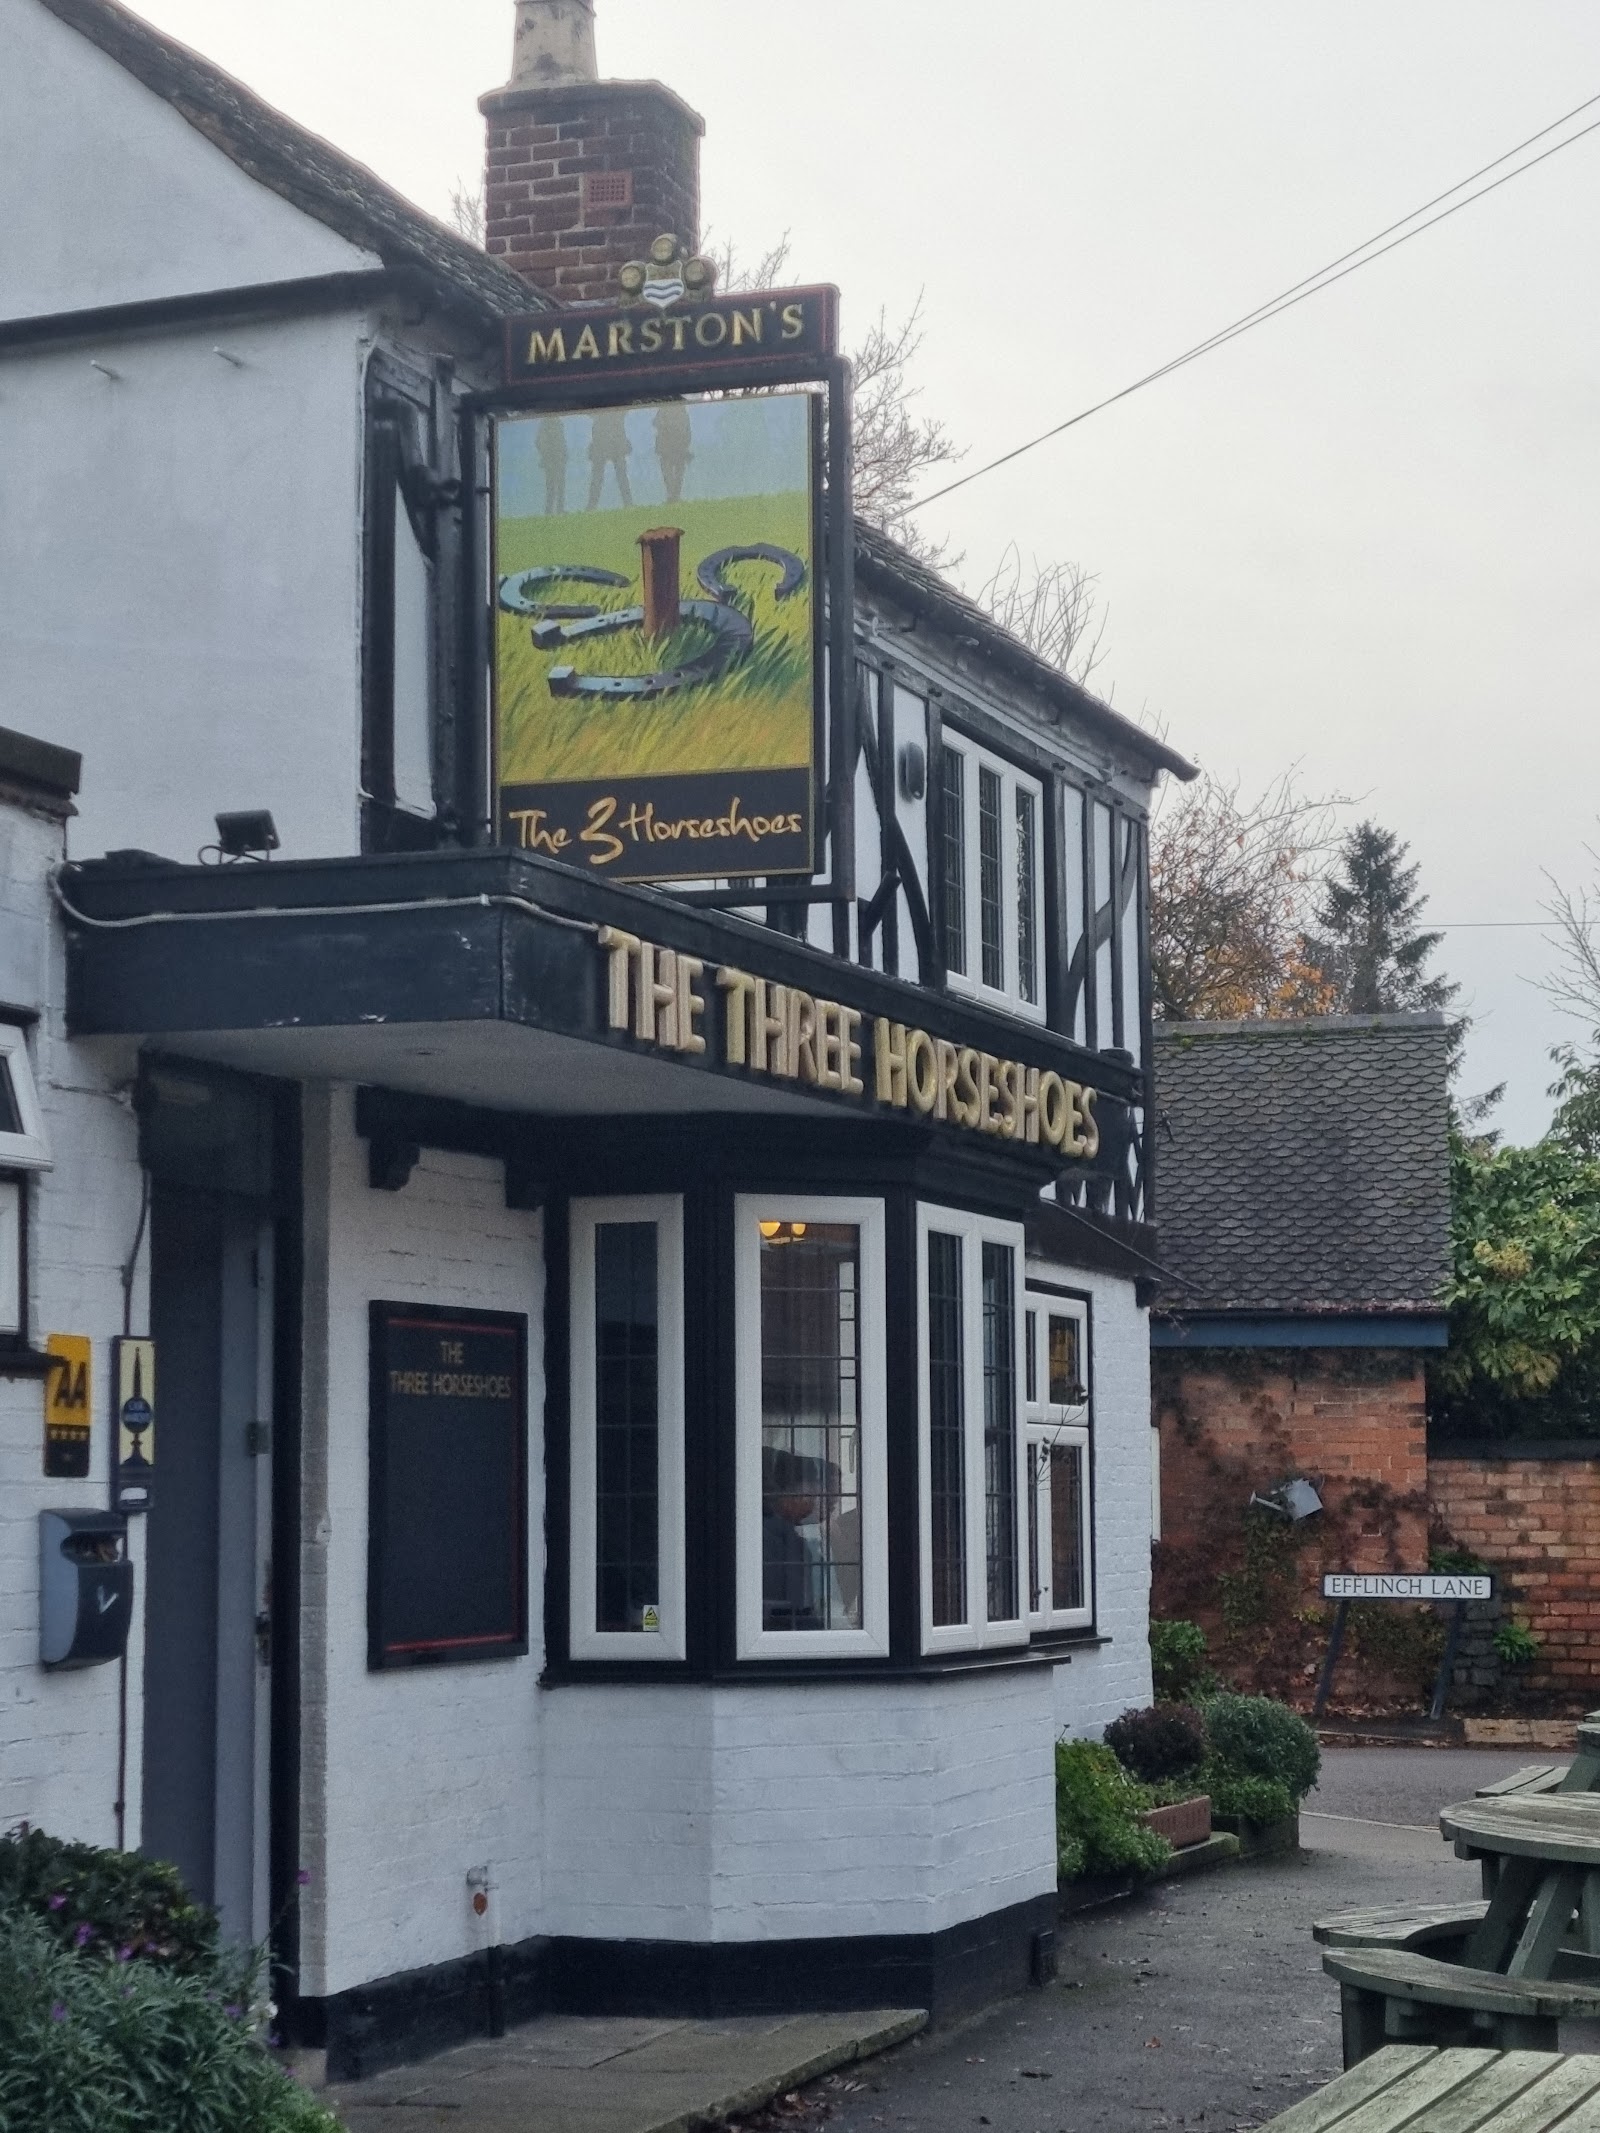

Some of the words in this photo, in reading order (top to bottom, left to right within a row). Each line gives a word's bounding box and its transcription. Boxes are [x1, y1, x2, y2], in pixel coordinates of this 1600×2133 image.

[527, 301, 804, 364] MARSTON'S
[509, 809, 572, 854] The
[580, 796, 624, 864] 3
[619, 796, 802, 842] Horseshoes
[598, 924, 706, 1053] THE
[716, 966, 864, 1095] THREE
[873, 1016, 1099, 1159] HORSESHOES
[440, 1341, 464, 1364] THE
[390, 1370, 428, 1395] THREE
[432, 1372, 512, 1398] HORSESHOES
[1332, 1577, 1422, 1594] EFFLINCH
[1432, 1579, 1484, 1595] LANE
